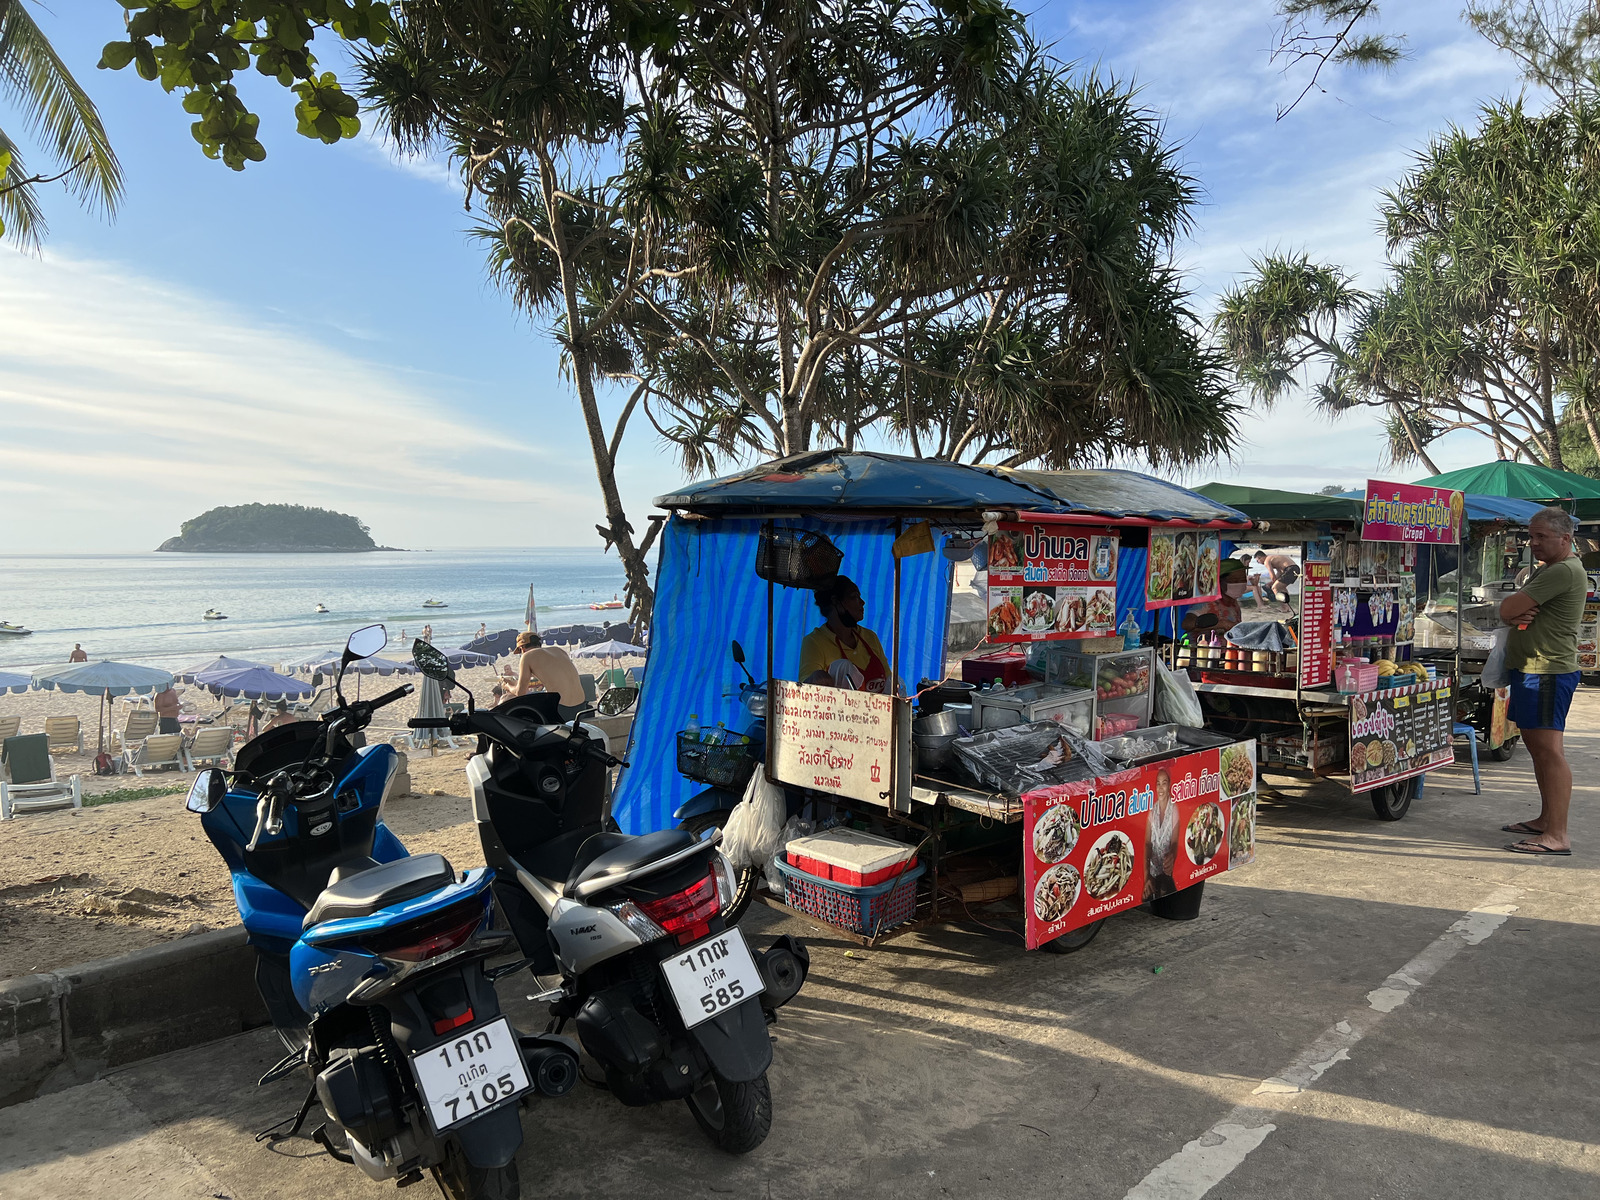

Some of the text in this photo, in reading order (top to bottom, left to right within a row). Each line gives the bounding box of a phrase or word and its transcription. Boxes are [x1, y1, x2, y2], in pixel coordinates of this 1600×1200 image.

[1025, 525, 1089, 560] ป้านวล
[1171, 772, 1198, 803] รสเด็ด
[1080, 783, 1154, 830] ป้านวล ส้มตำ
[703, 967, 727, 989] ภูเก็ต
[700, 979, 745, 1014] 585
[458, 1063, 489, 1088] ภูเก็ต
[444, 1073, 515, 1122] 7105
